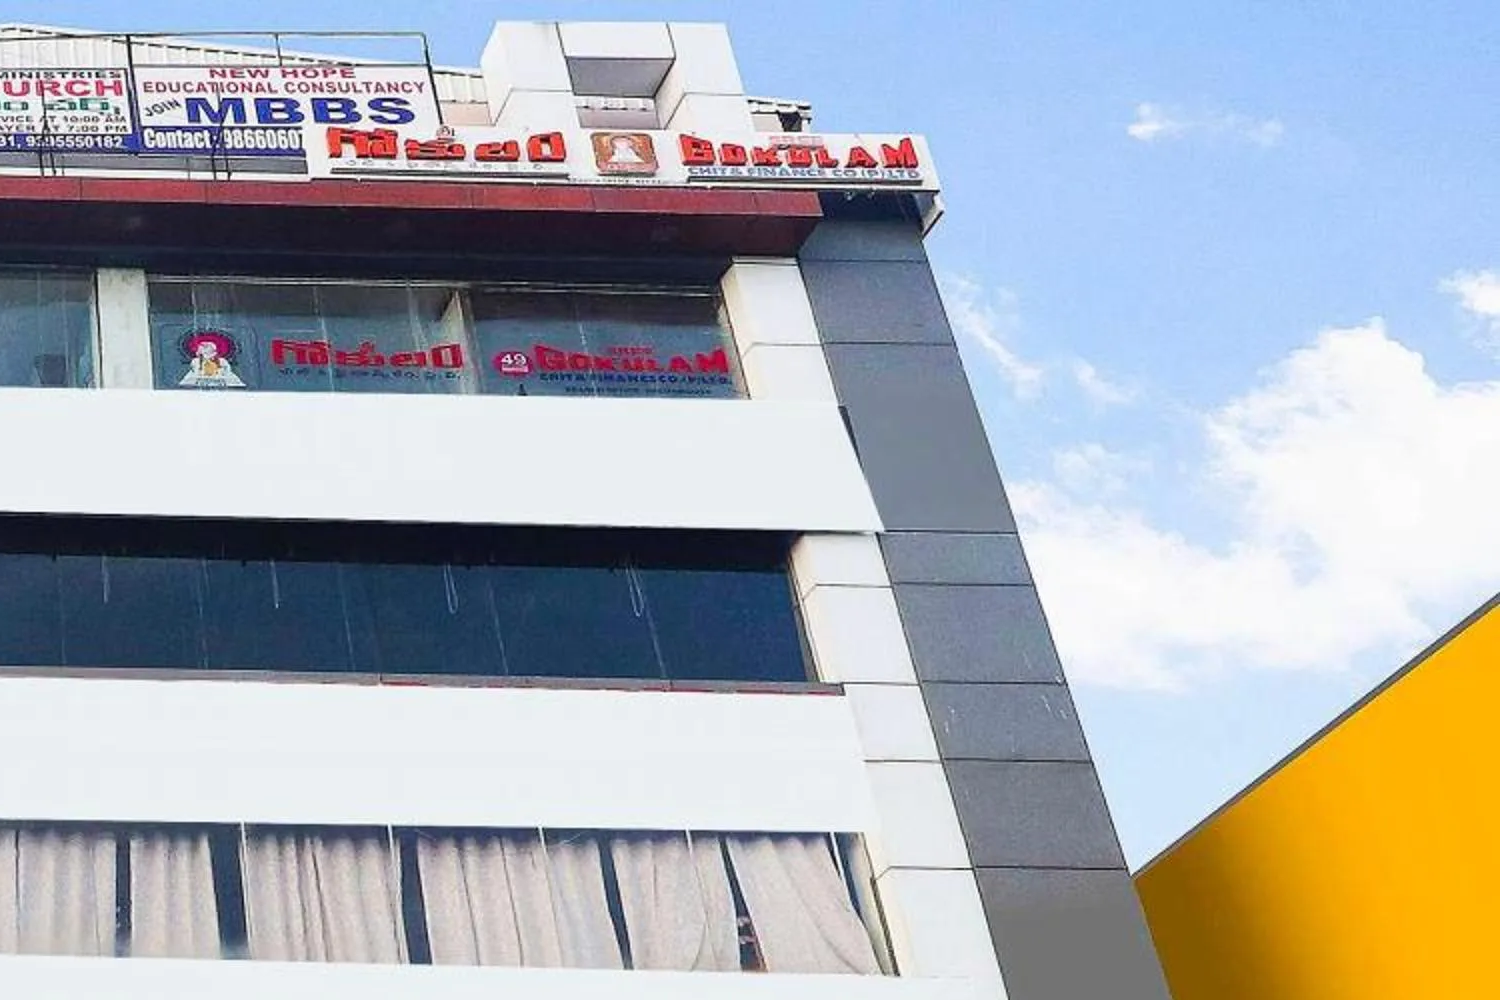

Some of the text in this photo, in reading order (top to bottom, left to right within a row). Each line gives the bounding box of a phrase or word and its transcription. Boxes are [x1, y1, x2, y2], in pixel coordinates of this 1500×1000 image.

[209, 68, 357, 79] NEW HOPE
[143, 81, 427, 94] EDUCATIONAL CONSULTANCY
[145, 97, 416, 125] JOIN MBBS
[104, 114, 128, 124] AM
[66, 124, 100, 133] 7:00
[104, 124, 129, 133] PM
[143, 127, 213, 149] Contact
[678, 133, 919, 169] GOKULAM
[748, 167, 825, 178] FINANCE
[534, 344, 729, 374] GOKULAM
